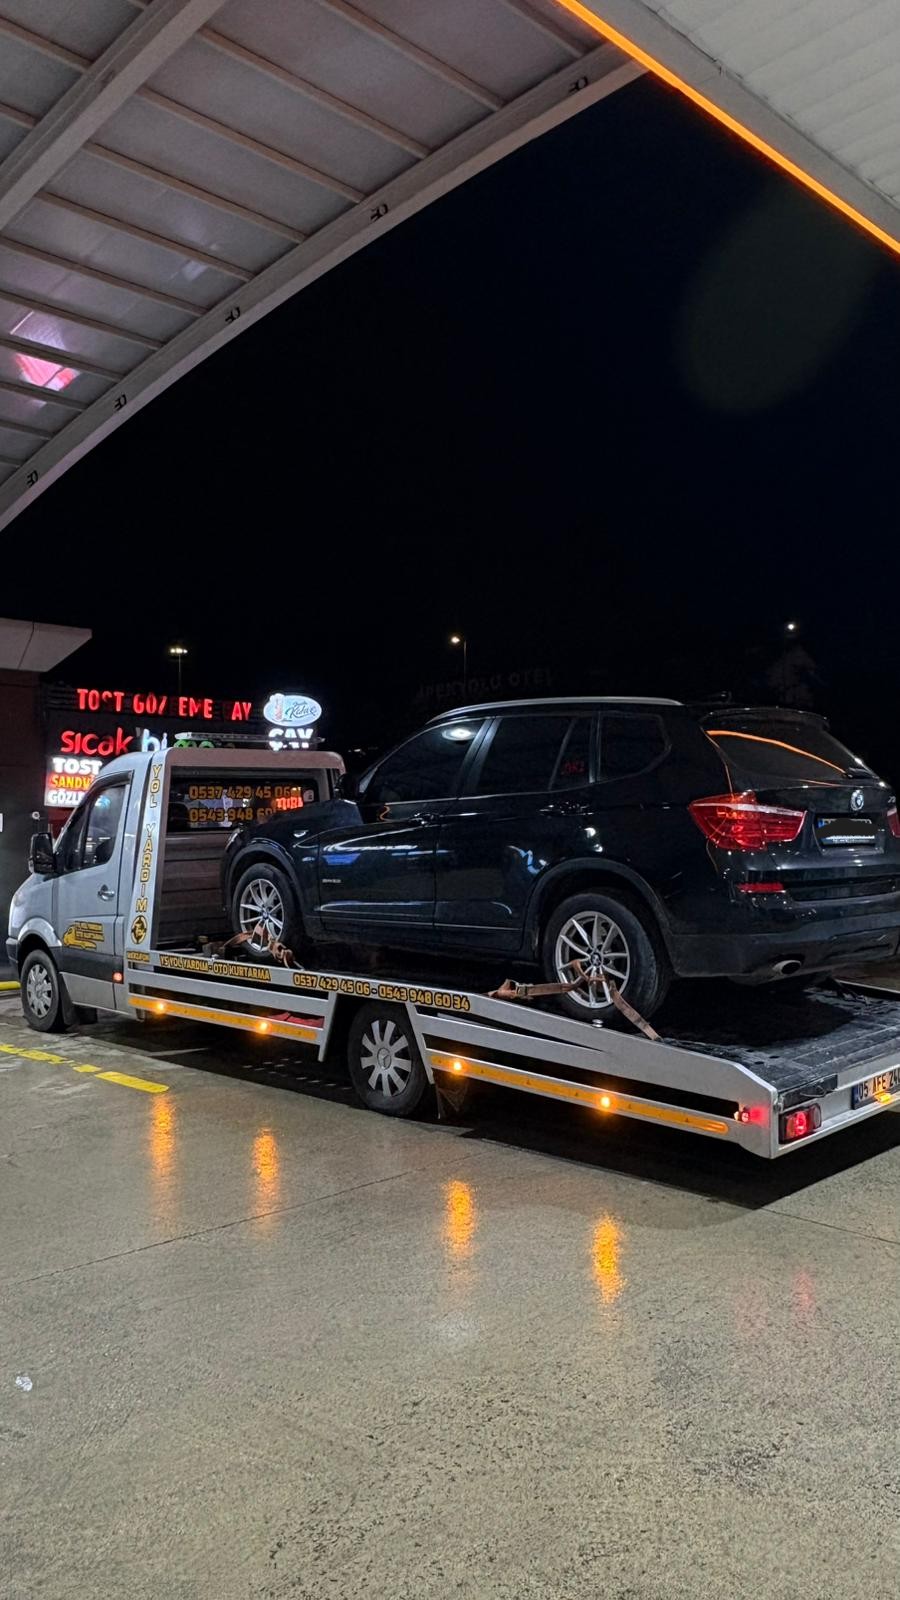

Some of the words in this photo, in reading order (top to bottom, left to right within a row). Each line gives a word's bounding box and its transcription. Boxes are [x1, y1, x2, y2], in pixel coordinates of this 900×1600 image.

[52, 757, 103, 776] TOST
[149, 765, 162, 808] YOL
[188, 785, 223, 799] 0537
[227, 786, 252, 799] 429
[255, 786, 272, 798] 45
[274, 786, 291, 798] 06
[189, 808, 225, 821] 0543
[227, 807, 254, 821] 948
[135, 823, 156, 913] YARDIM
[169, 956, 182, 968] YOL
[182, 958, 208, 971] YARDIM
[213, 962, 228, 974] OTO
[229, 964, 271, 981] KURTARMA
[293, 973, 317, 988] 0537
[319, 976, 339, 991] 429
[340, 979, 354, 993] 45
[356, 981, 371, 995] 06
[378, 984, 408, 1001] 0543
[409, 989, 432, 1005] 948
[434, 993, 451, 1008] 60
[452, 995, 470, 1011] 34
[859, 1080, 869, 1099] 05
